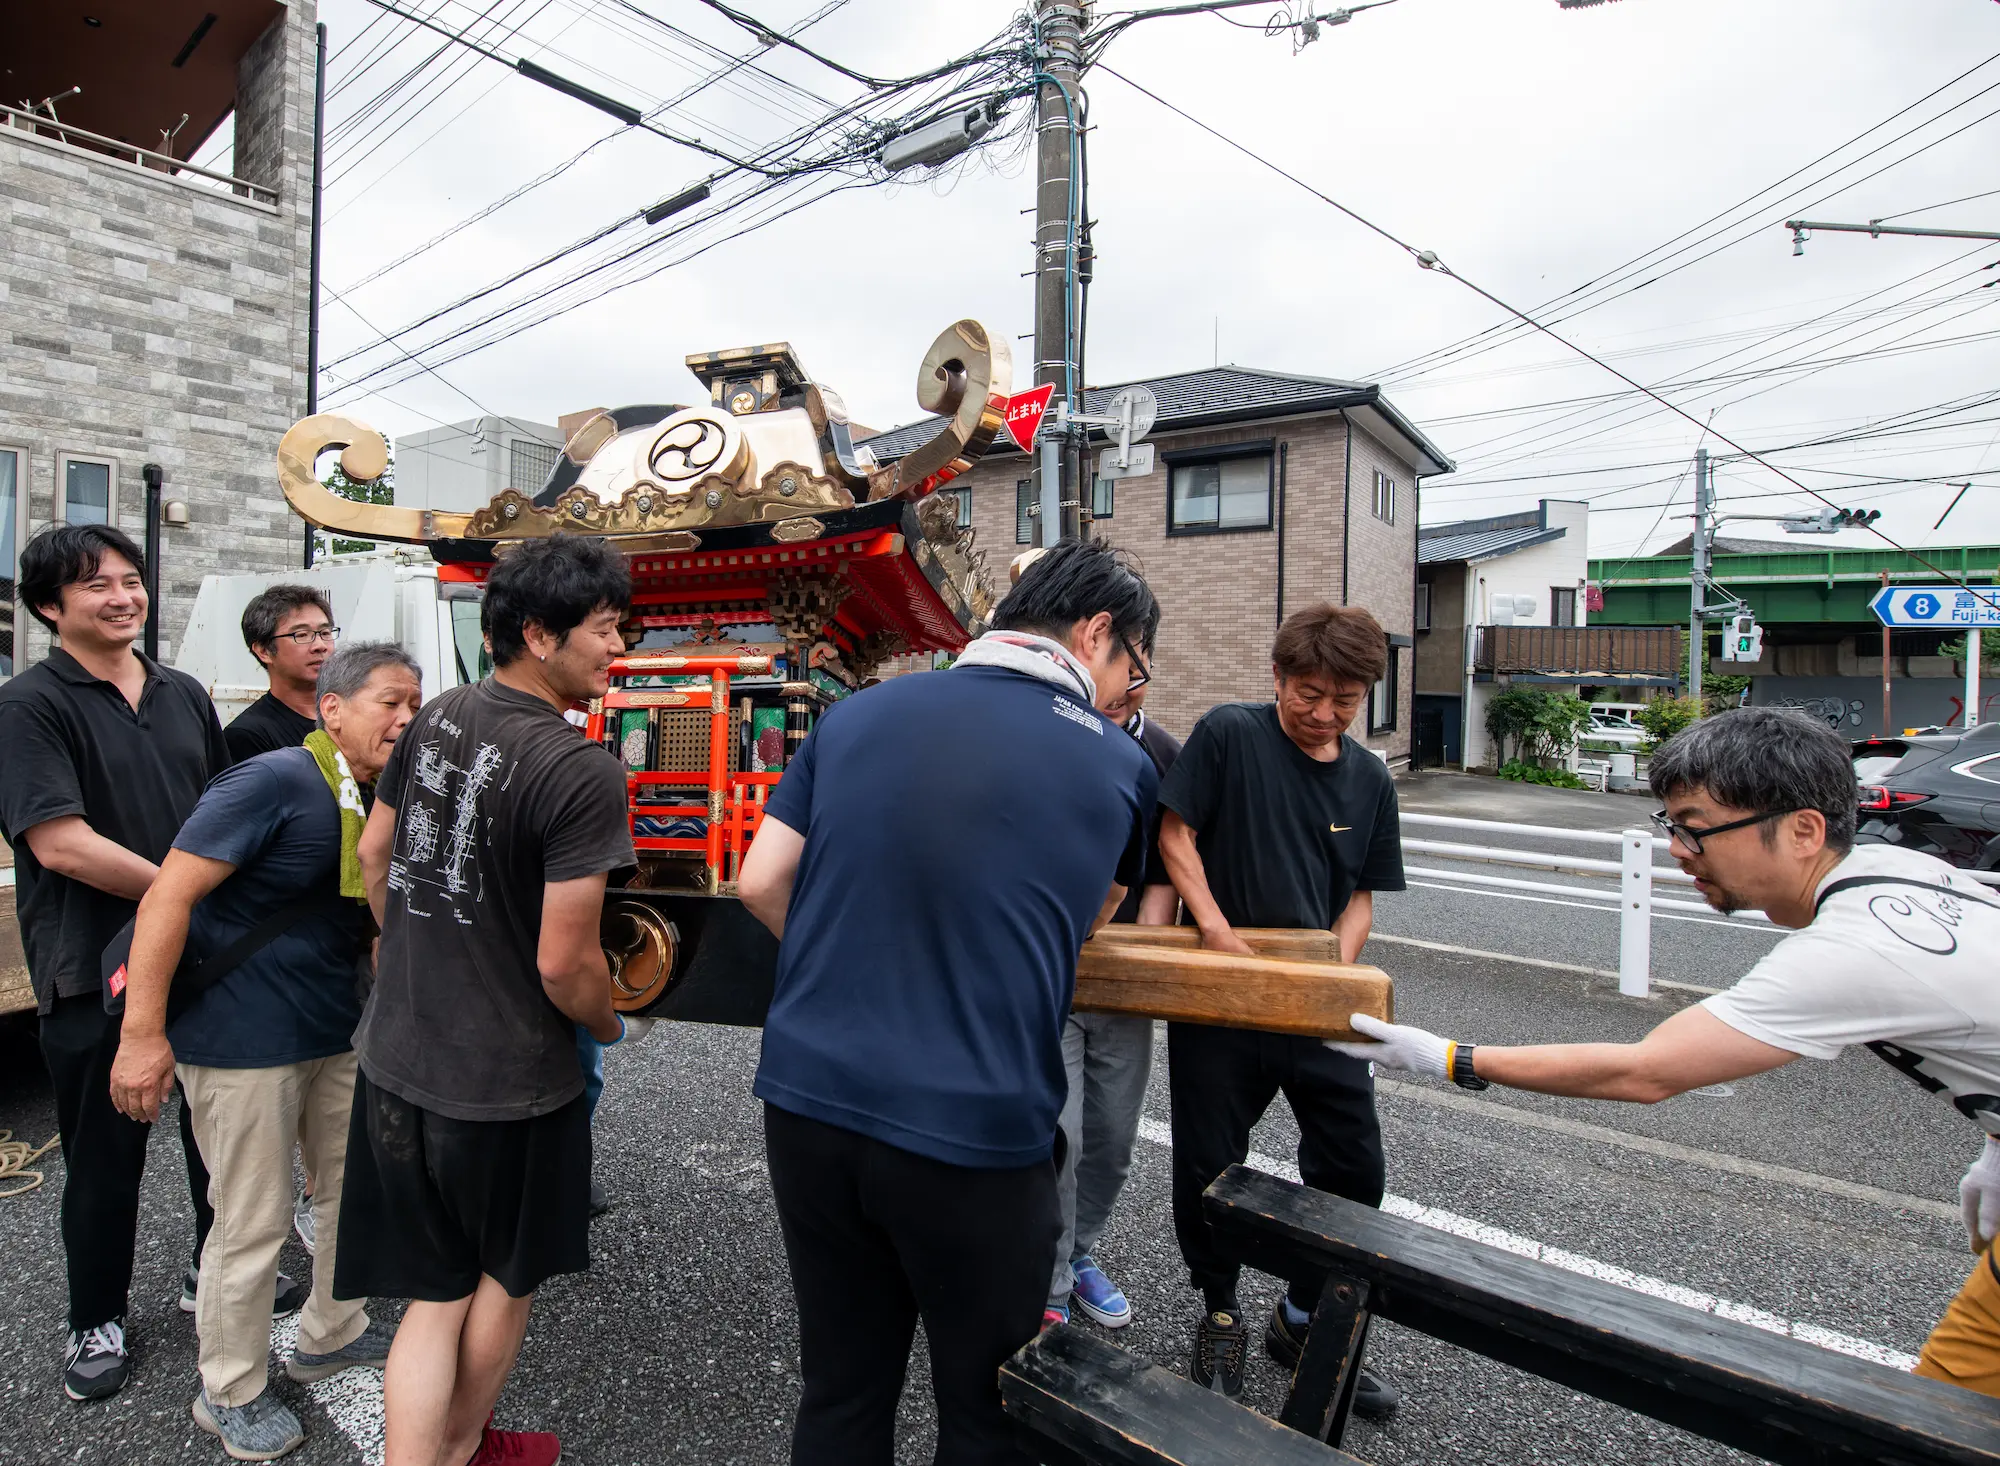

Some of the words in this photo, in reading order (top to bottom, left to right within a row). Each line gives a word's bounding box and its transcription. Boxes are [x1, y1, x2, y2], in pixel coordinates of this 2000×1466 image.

[1007, 400, 1042, 423] 止まれ
[1915, 598, 1930, 616] 8
[1053, 695, 1072, 707] JAPAN
